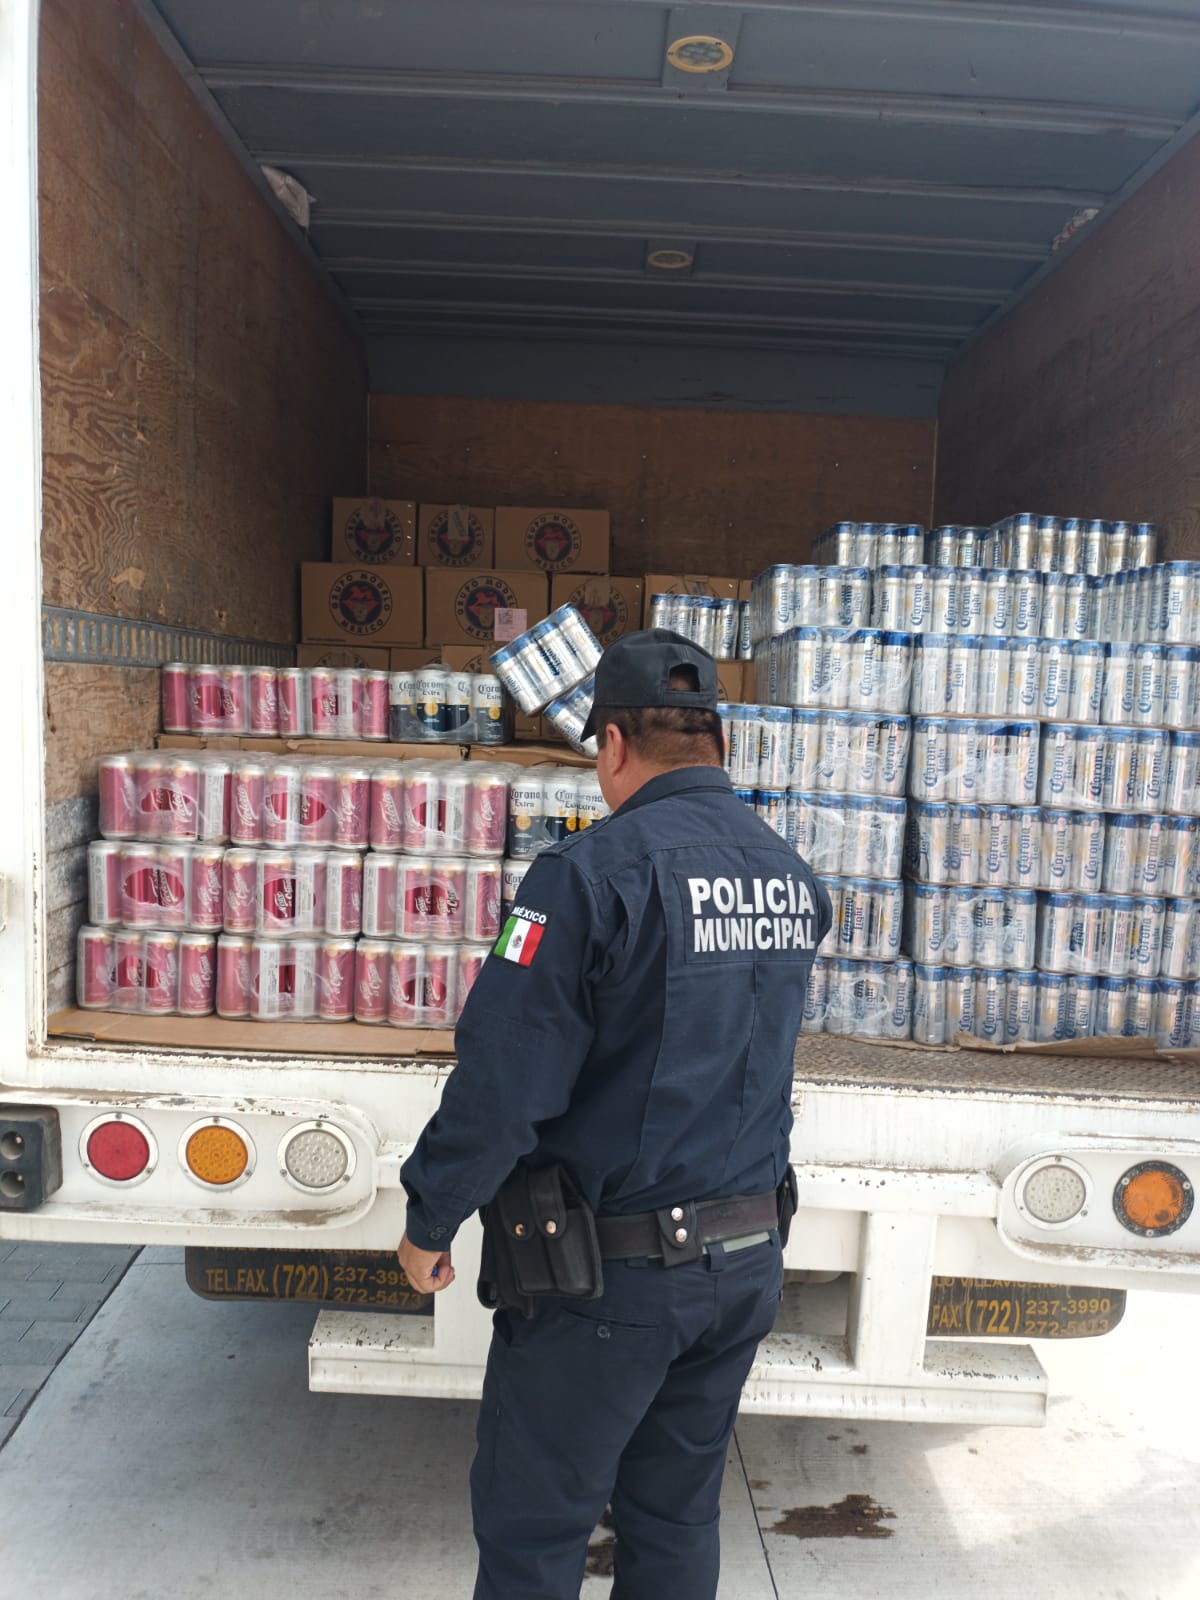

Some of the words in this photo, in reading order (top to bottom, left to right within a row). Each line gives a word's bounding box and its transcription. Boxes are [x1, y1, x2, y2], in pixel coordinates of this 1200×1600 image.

[526, 516, 547, 549] GRUPO
[331, 574, 353, 609] GRUPO
[361, 572, 391, 611] MODELO
[457, 580, 479, 616] GRUPO
[486, 578, 516, 608] MODEL
[911, 584, 923, 626] Corona
[1016, 588, 1028, 631] Corona
[340, 619, 384, 634] MEXICO
[1043, 659, 1058, 707] Corona
[1138, 665, 1152, 713] Corona
[1050, 746, 1065, 793] Corona
[987, 826, 1000, 873] Corona
[1017, 827, 1031, 874] Corona
[1052, 830, 1065, 877] Corona
[1085, 833, 1099, 879] Corona
[512, 905, 547, 925] MÉXICO
[688, 874, 815, 915] POLICÍA
[694, 917, 816, 953] MUNICIPAL
[929, 905, 940, 951] Corona
[1137, 918, 1151, 964] Corona
[273, 1264, 329, 1299] (722)
[333, 1266, 409, 1287] 237-399
[965, 1299, 1021, 1334] (722)
[1025, 1298, 1111, 1316] 237-3990
